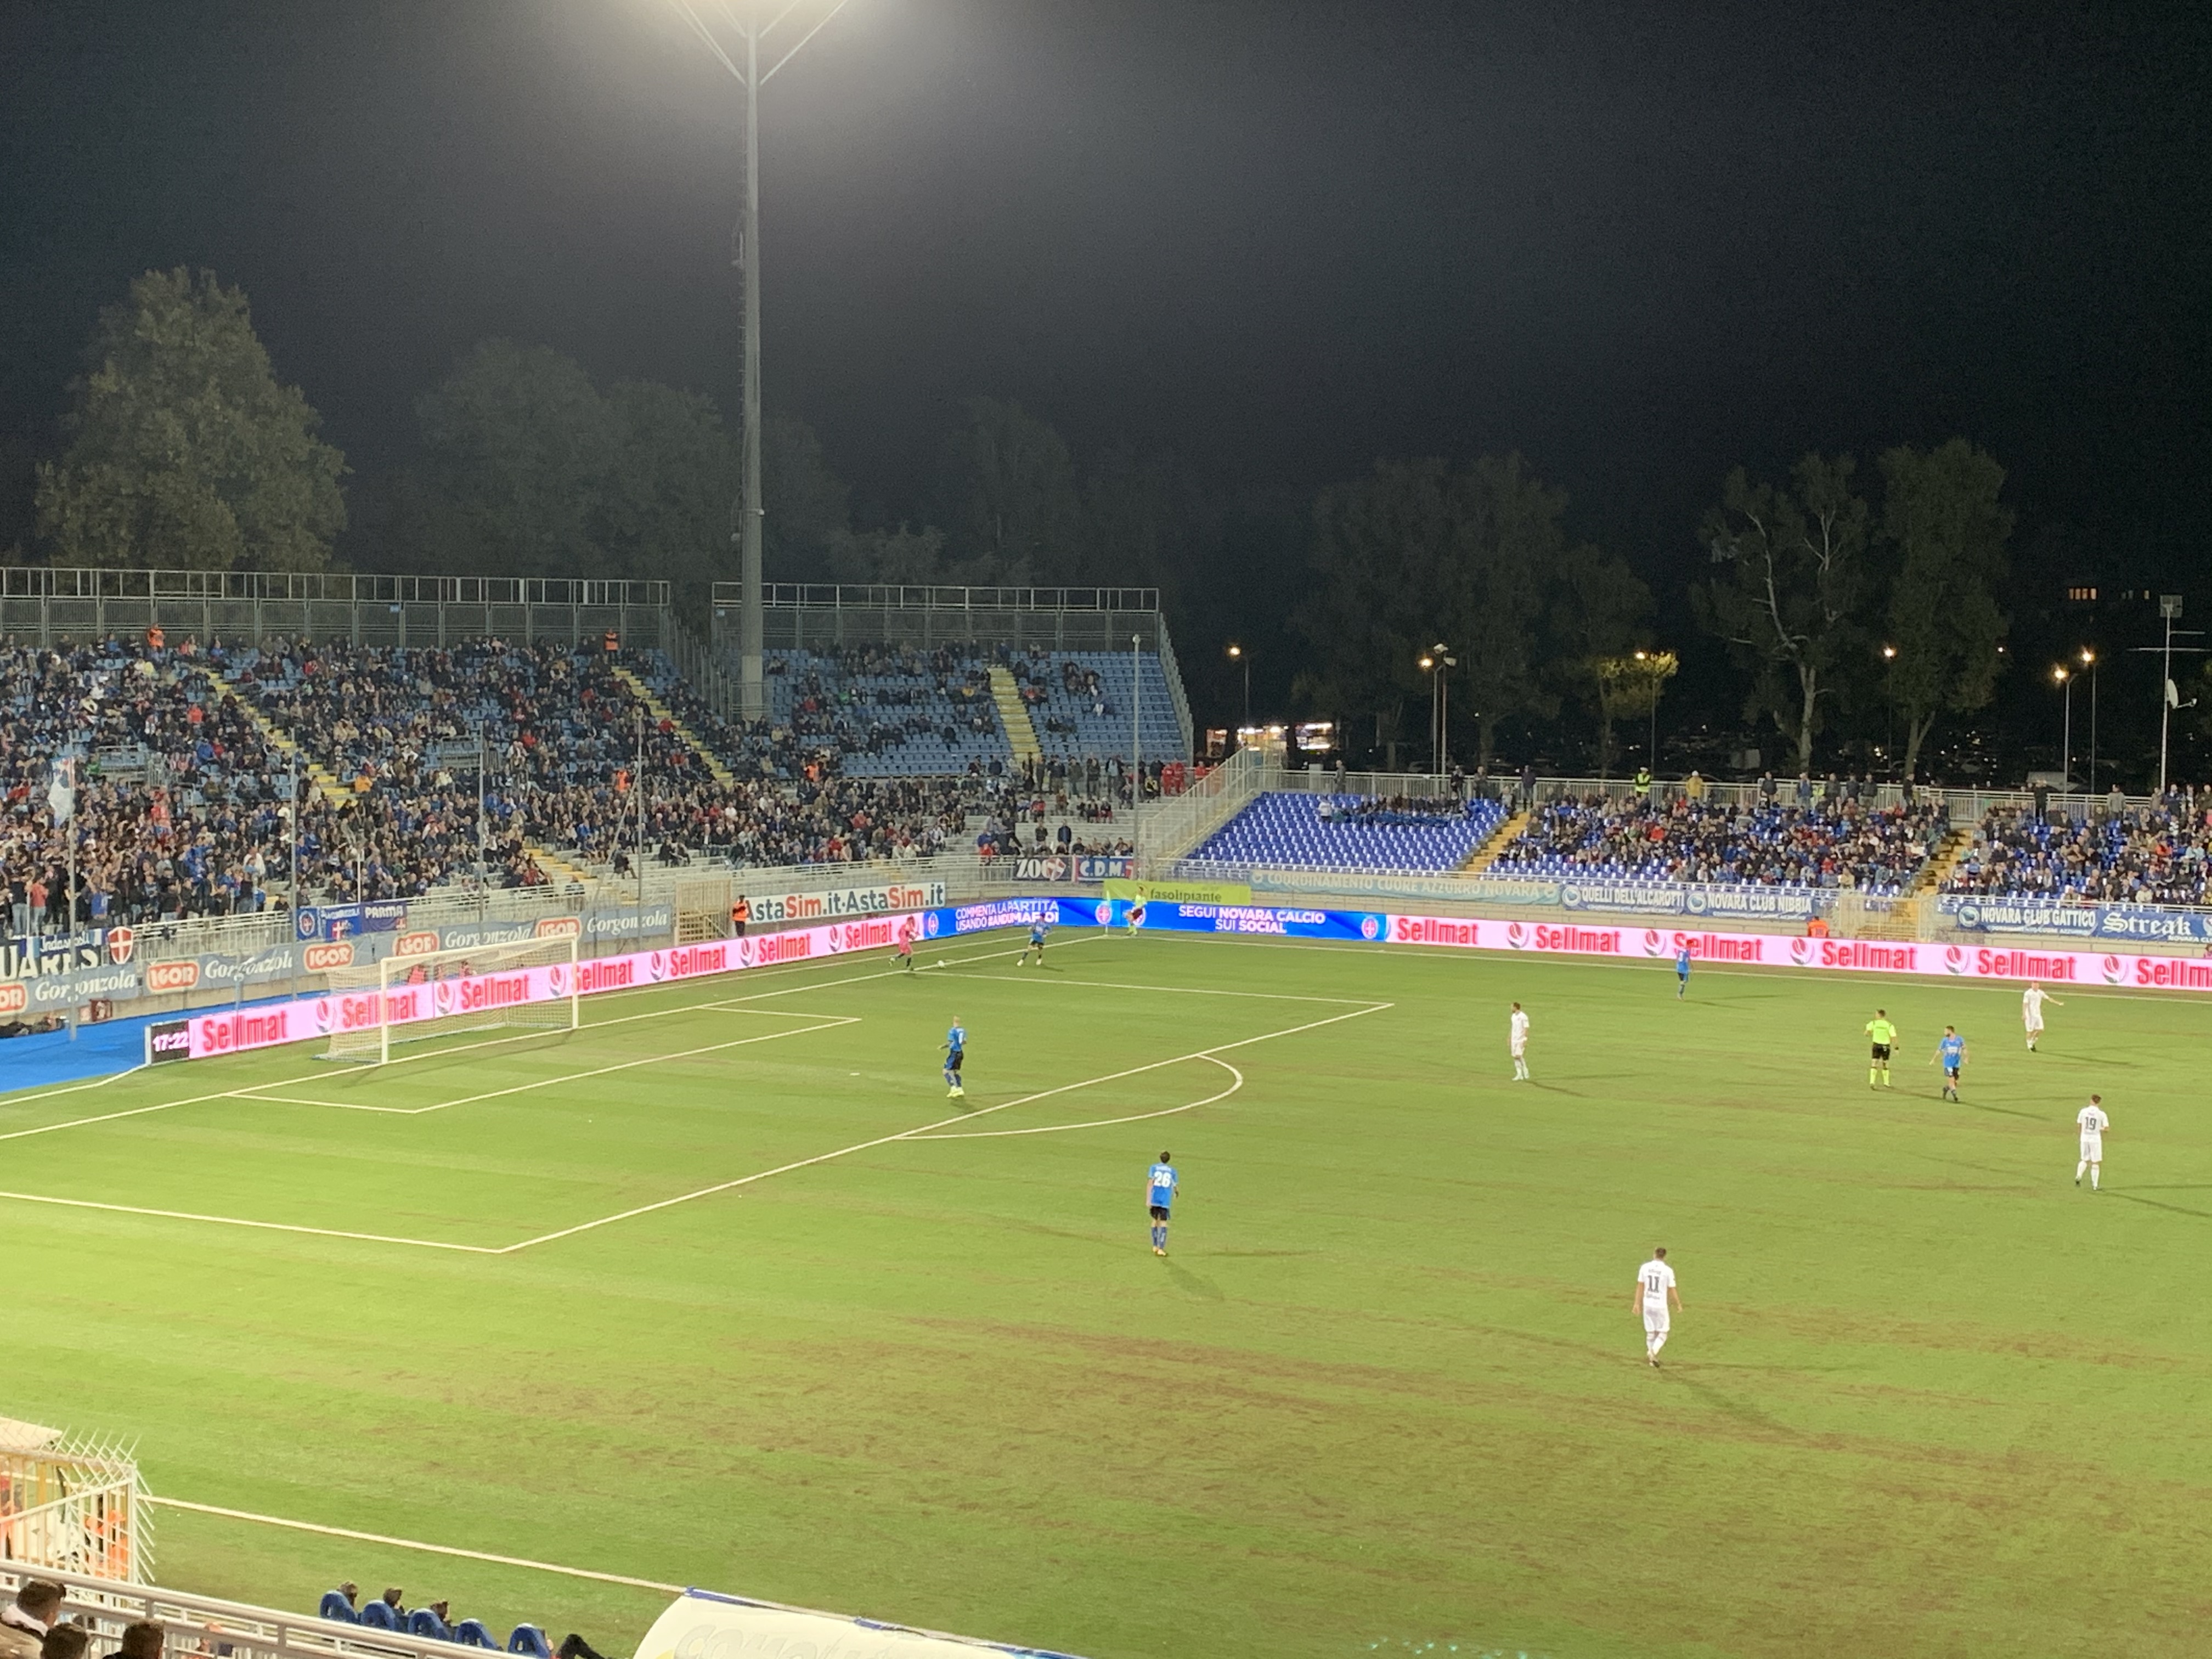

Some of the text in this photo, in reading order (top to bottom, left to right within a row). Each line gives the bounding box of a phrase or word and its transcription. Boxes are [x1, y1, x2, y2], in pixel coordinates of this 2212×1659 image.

[1080, 857, 1125, 877] C.D.M.
[1268, 873, 1539, 898] COORDINAMENTO CUORE AZZURRO NOVARA
[1150, 889, 1222, 904] fasolipiante
[1582, 887, 1685, 907] QUELLI DELL'ALCAROTTI
[1708, 893, 1812, 913] NOVARA CLUB NIBBIA
[365, 906, 404, 918] PARMA
[955, 900, 1059, 920] COMMENTA LA PARTITA
[1178, 905, 1325, 924] SEGUI NOVARA CALCIO
[1981, 907, 2096, 927] NOVARA CLUB GATTICO
[955, 912, 1059, 932] USANDO #ANDUMAFOI
[1216, 918, 1286, 934] SUI SOCIAL
[2102, 912, 2192, 935] Streak
[1397, 918, 1480, 945] Sellmat
[1536, 926, 1621, 952] Sellmat
[1673, 933, 1763, 961] Sellmat
[1822, 941, 1917, 970] Sellmat
[1977, 949, 2076, 980] Sellmat
[149, 966, 193, 987] IGOR
[310, 949, 349, 966] IGOR
[202, 1010, 288, 1052] Sellmat
[461, 974, 529, 1009] Sellmat
[670, 945, 726, 977] Sellmat
[758, 933, 811, 963] Sellmat
[845, 920, 893, 949] Sellmat
[153, 1031, 189, 1052] 17:22
[2085, 1116, 2097, 1131] 19
[1153, 1170, 1172, 1188] 26
[1647, 1275, 1660, 1294] 11
